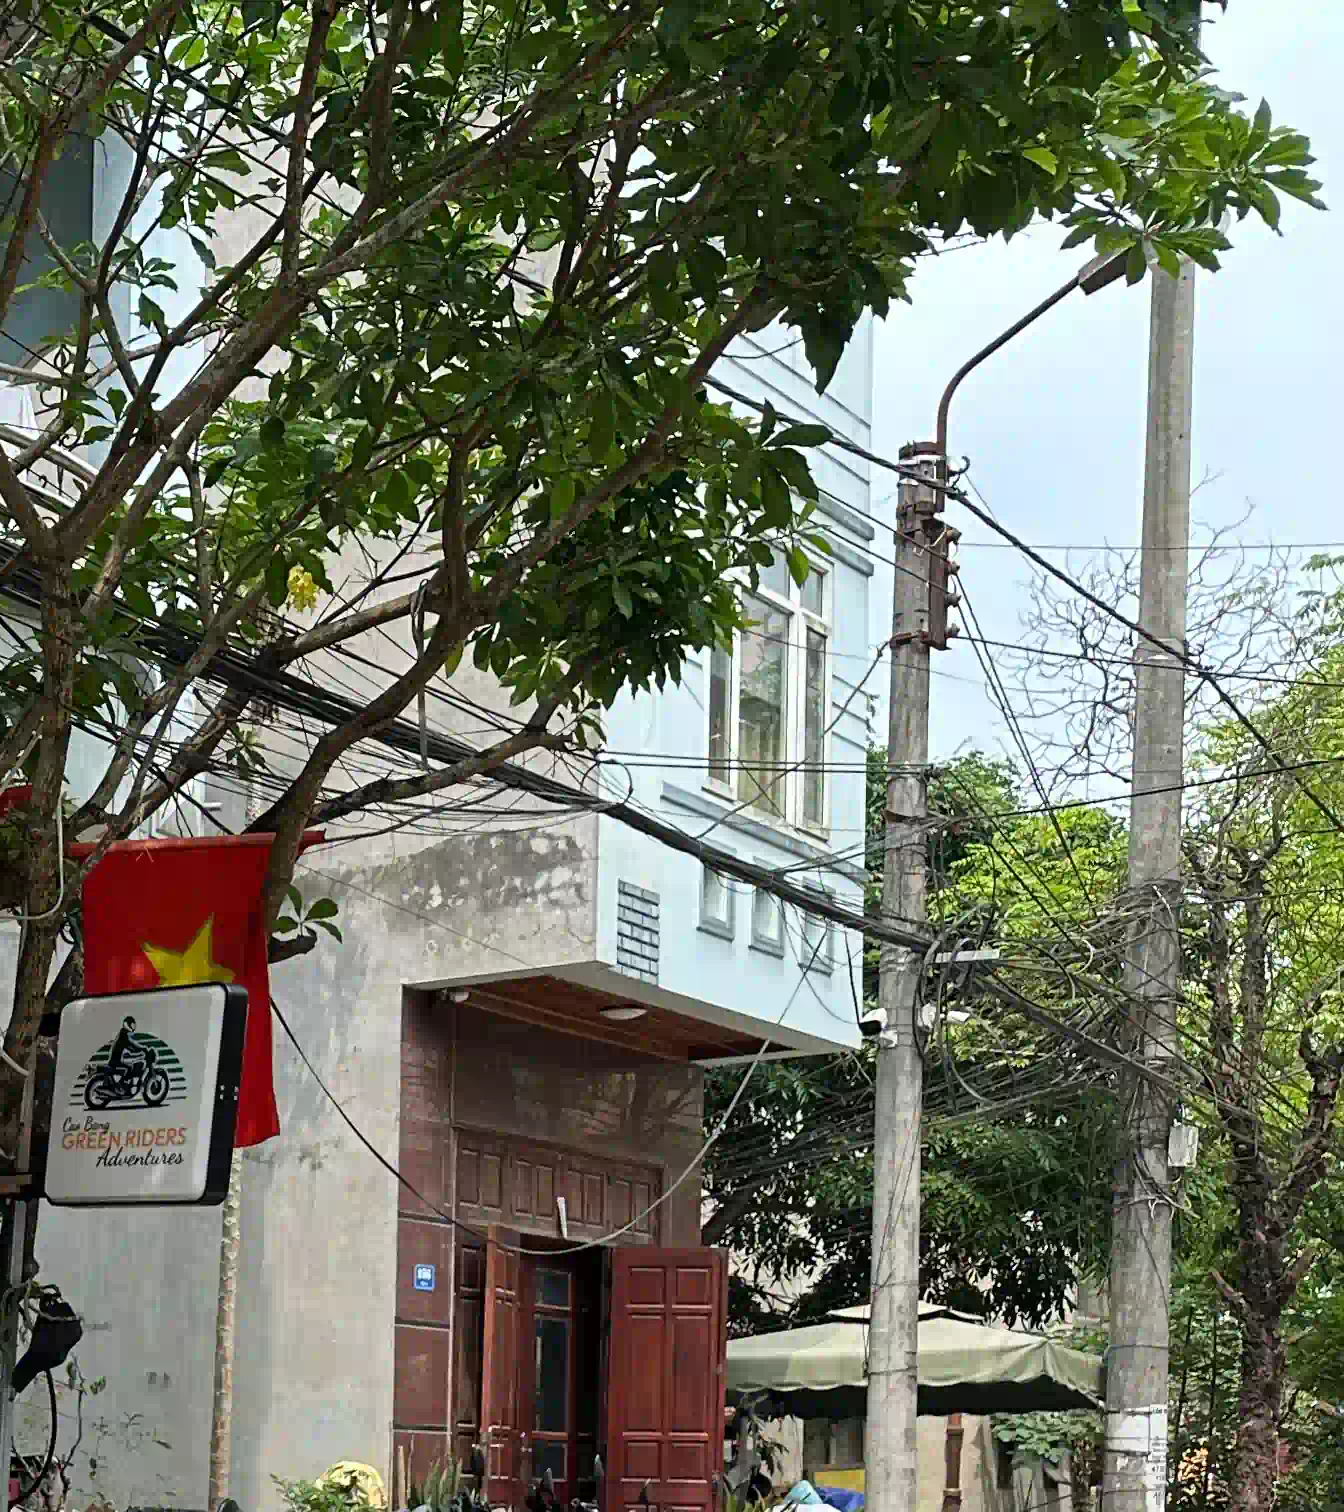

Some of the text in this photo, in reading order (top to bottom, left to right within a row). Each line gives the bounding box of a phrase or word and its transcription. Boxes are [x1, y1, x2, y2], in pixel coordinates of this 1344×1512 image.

[62, 1127, 189, 1151] GREEN RIDERS
[95, 1146, 185, 1168] Adventures
